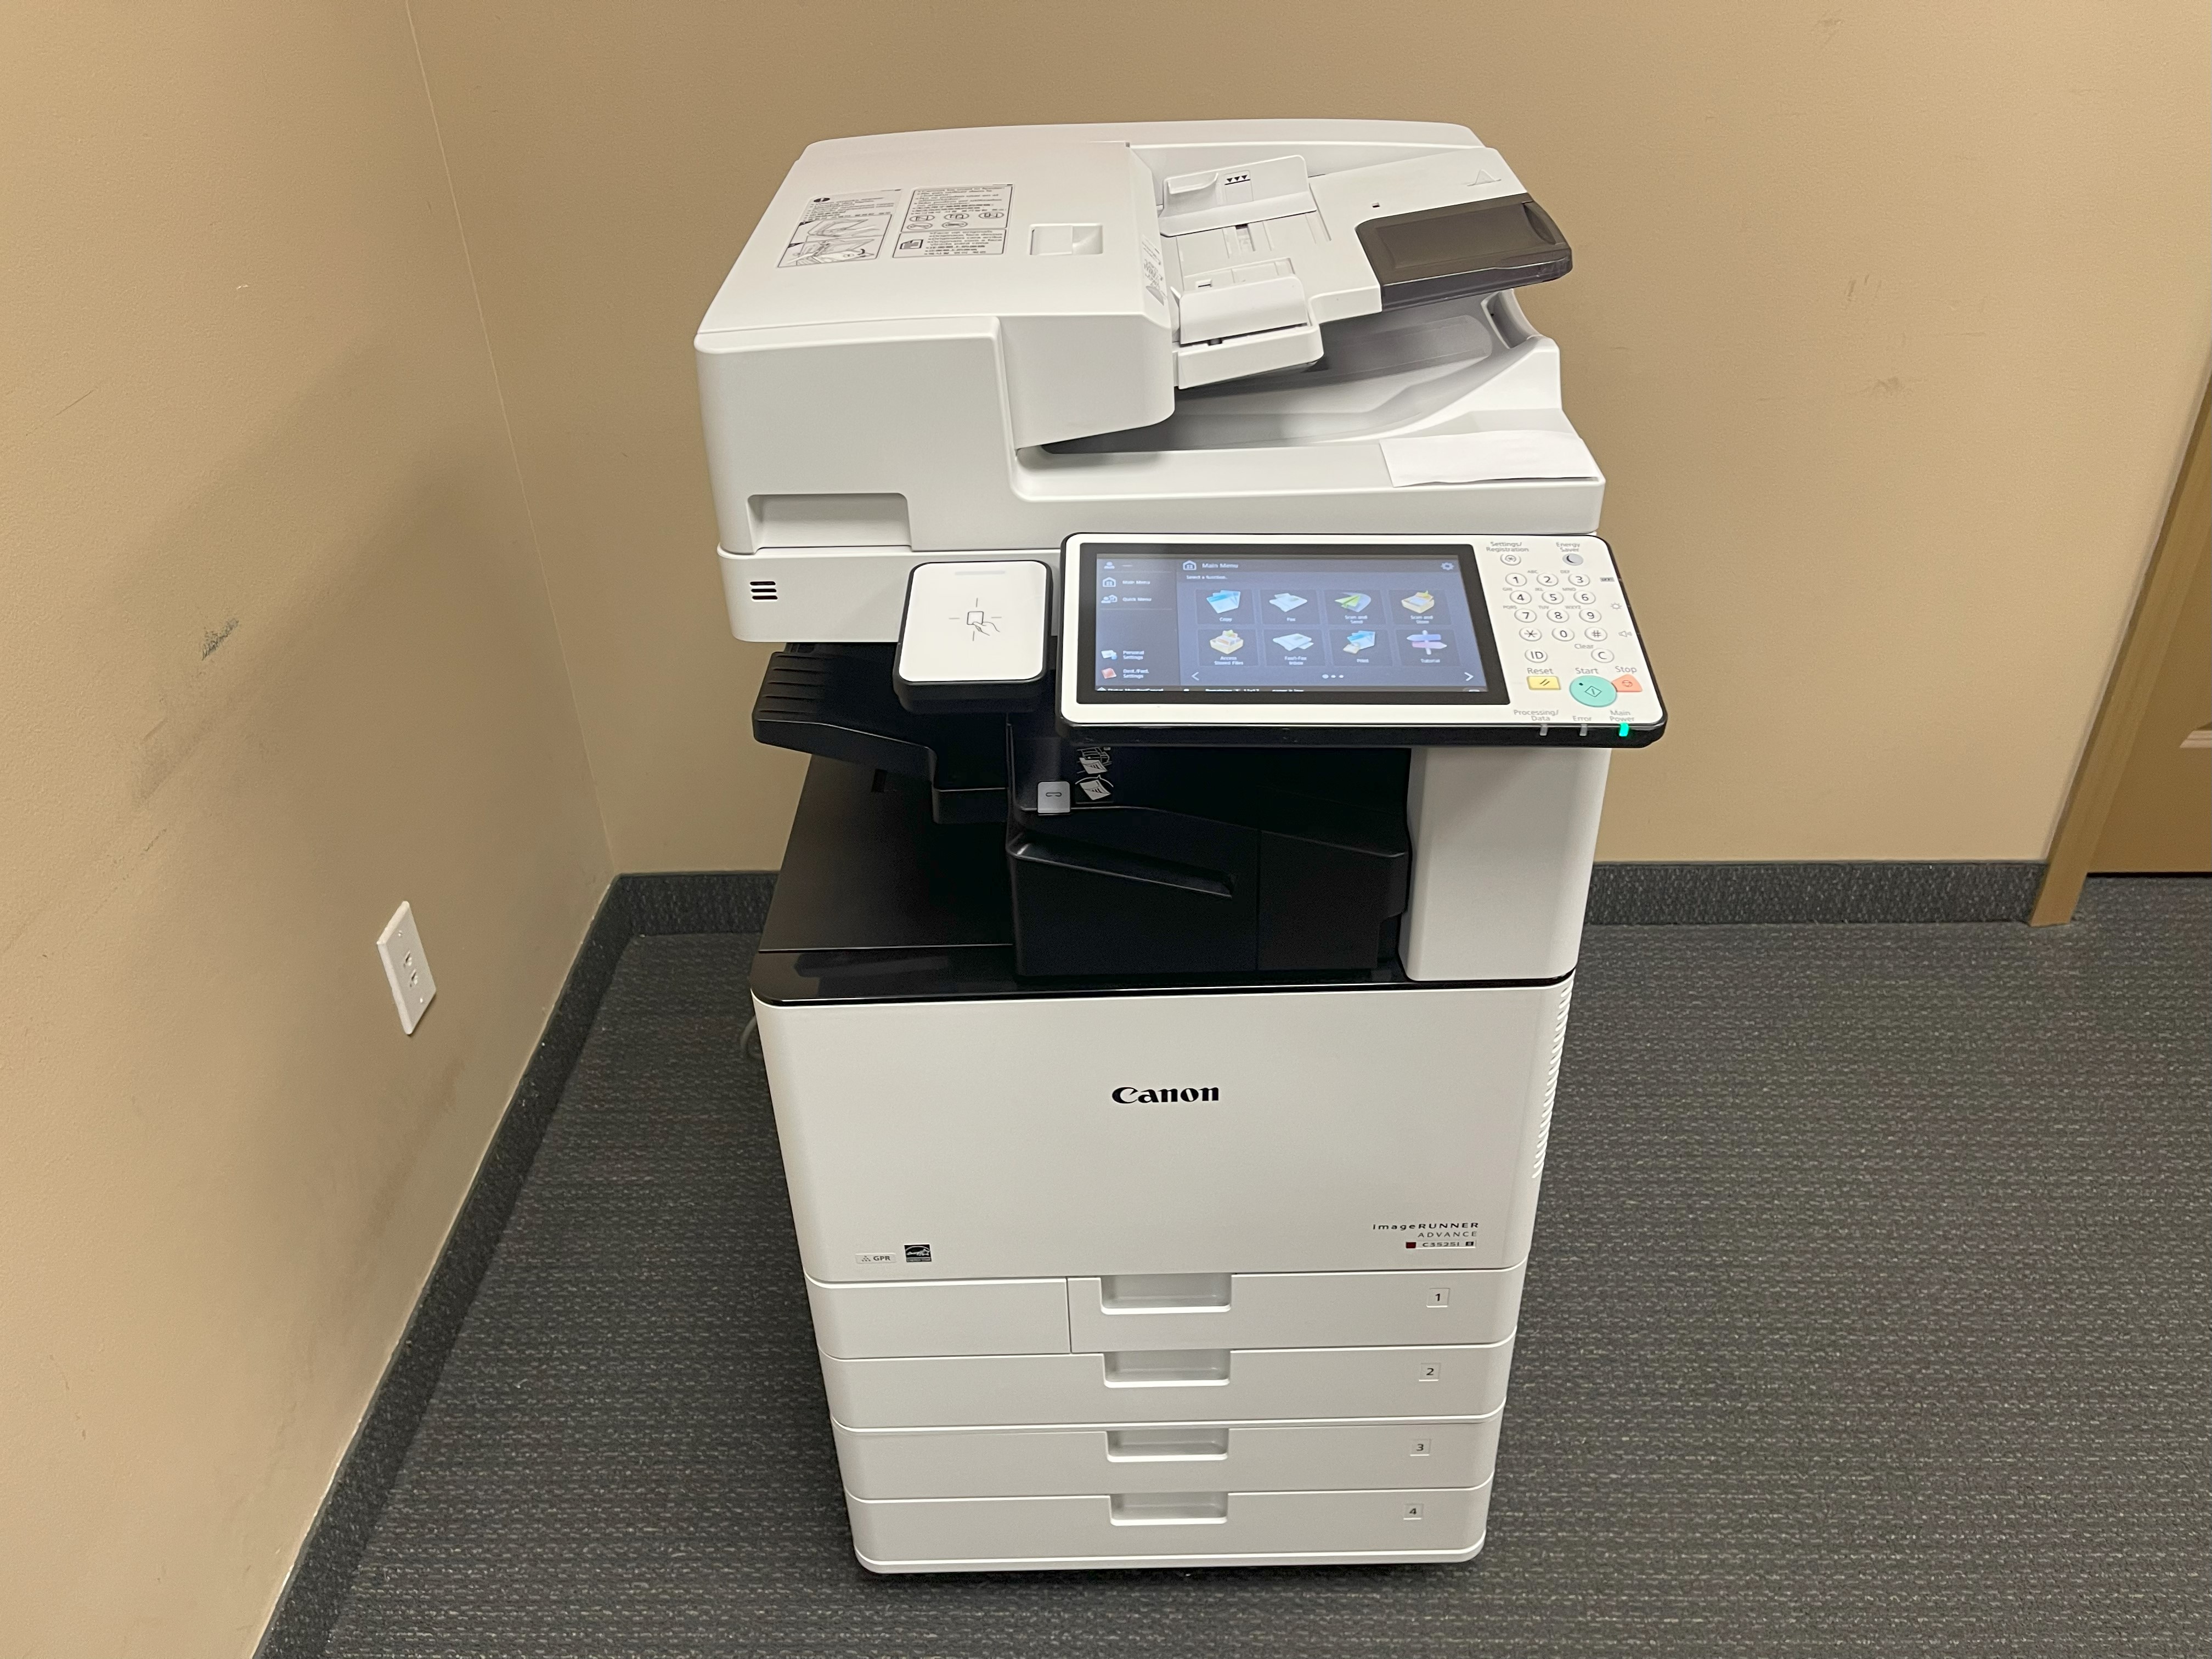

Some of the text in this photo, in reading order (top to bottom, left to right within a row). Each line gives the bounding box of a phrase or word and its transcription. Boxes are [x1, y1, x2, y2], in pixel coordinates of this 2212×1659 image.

[1598, 651, 1607, 659] C
[1615, 665, 1637, 674] Stop
[1111, 1086, 1219, 1104] Canon
[1435, 1293, 1441, 1301] 1
[1426, 1368, 1435, 1376] 2
[1415, 1443, 1424, 1452] 3
